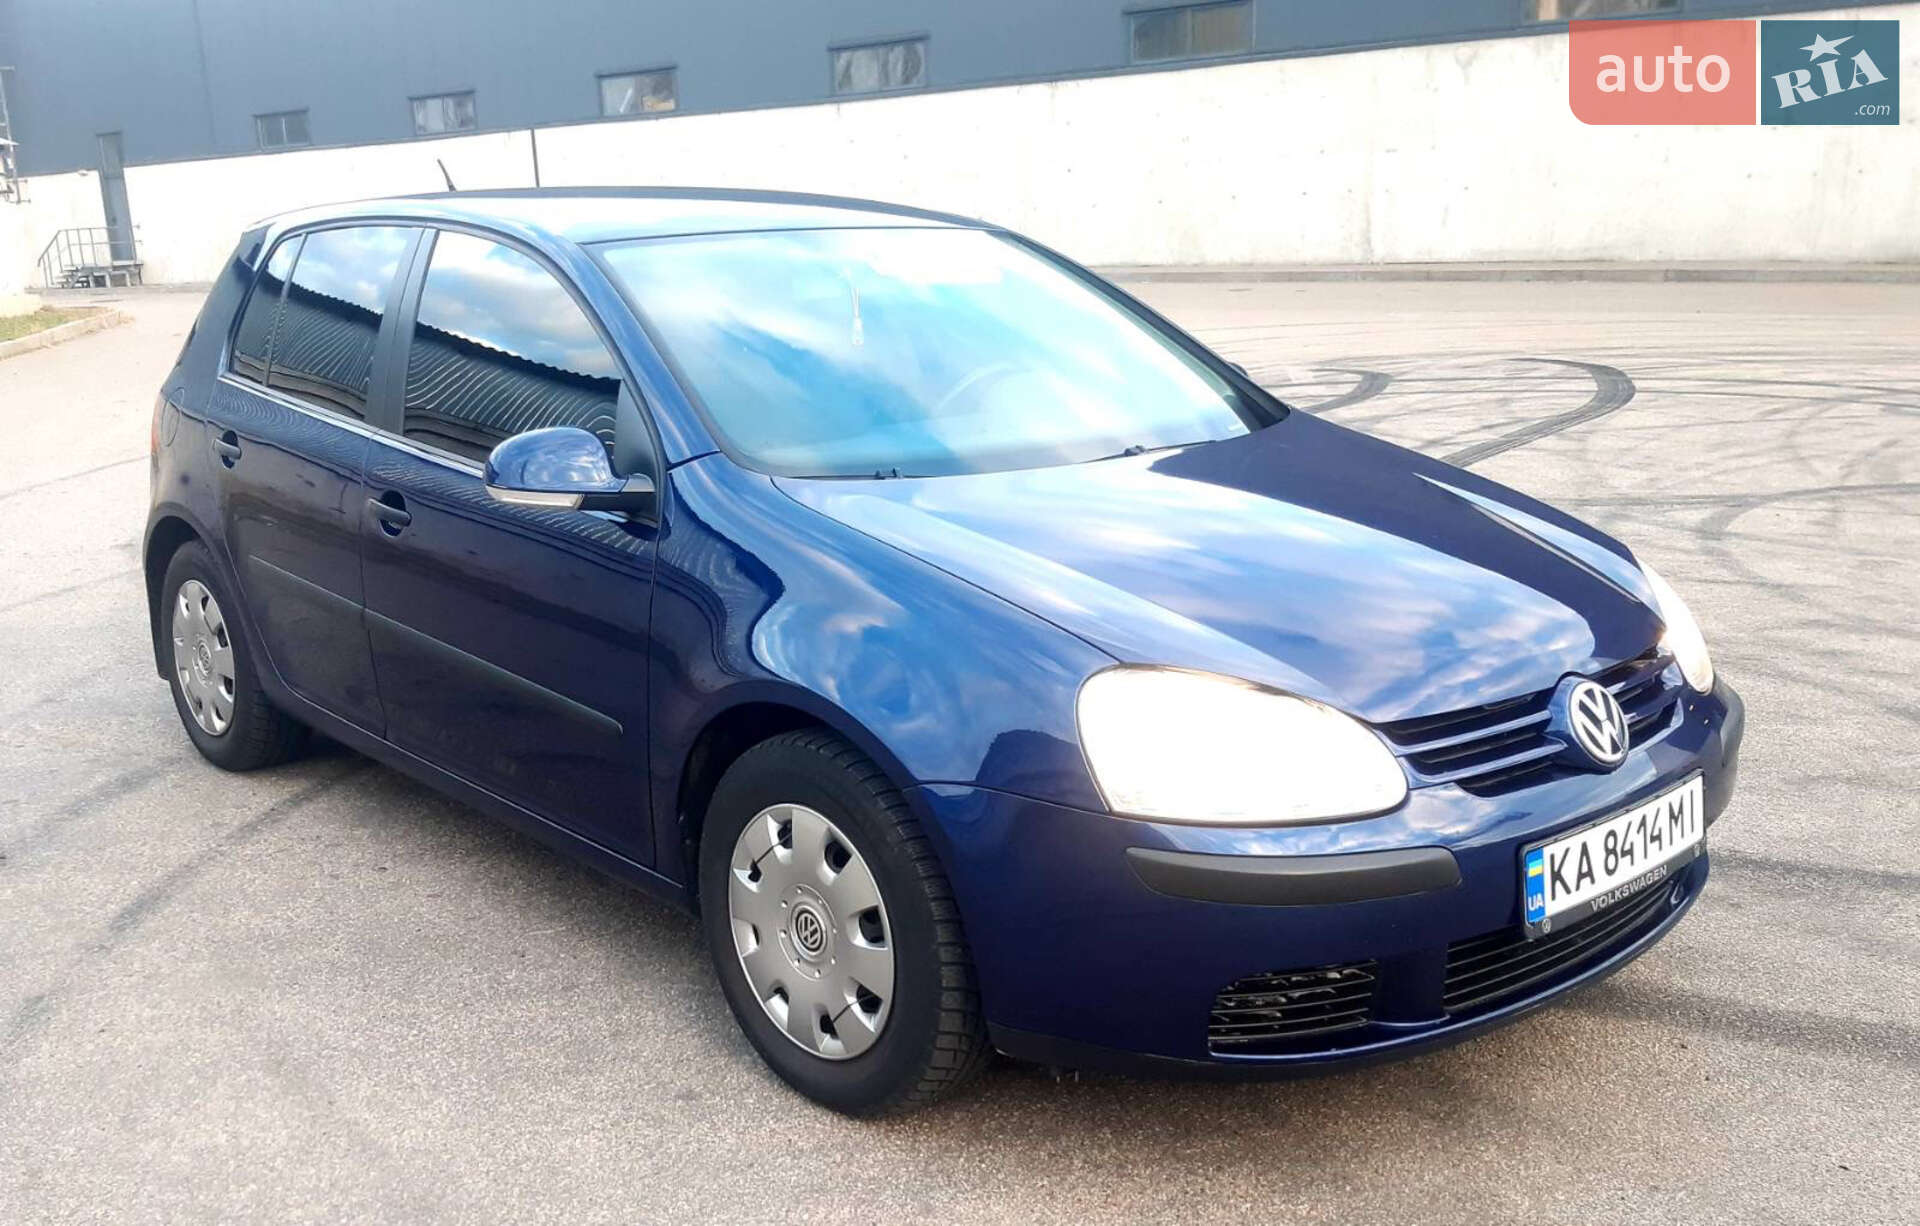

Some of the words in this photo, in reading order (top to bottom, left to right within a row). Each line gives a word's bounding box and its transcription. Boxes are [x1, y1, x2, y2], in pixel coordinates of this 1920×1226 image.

[1550, 841, 1596, 901] KA
[1603, 807, 1663, 877] 8414
[1668, 789, 1694, 846] MI
[1528, 894, 1545, 911] UA
[1590, 865, 1668, 913] VOLKSWAGEN
